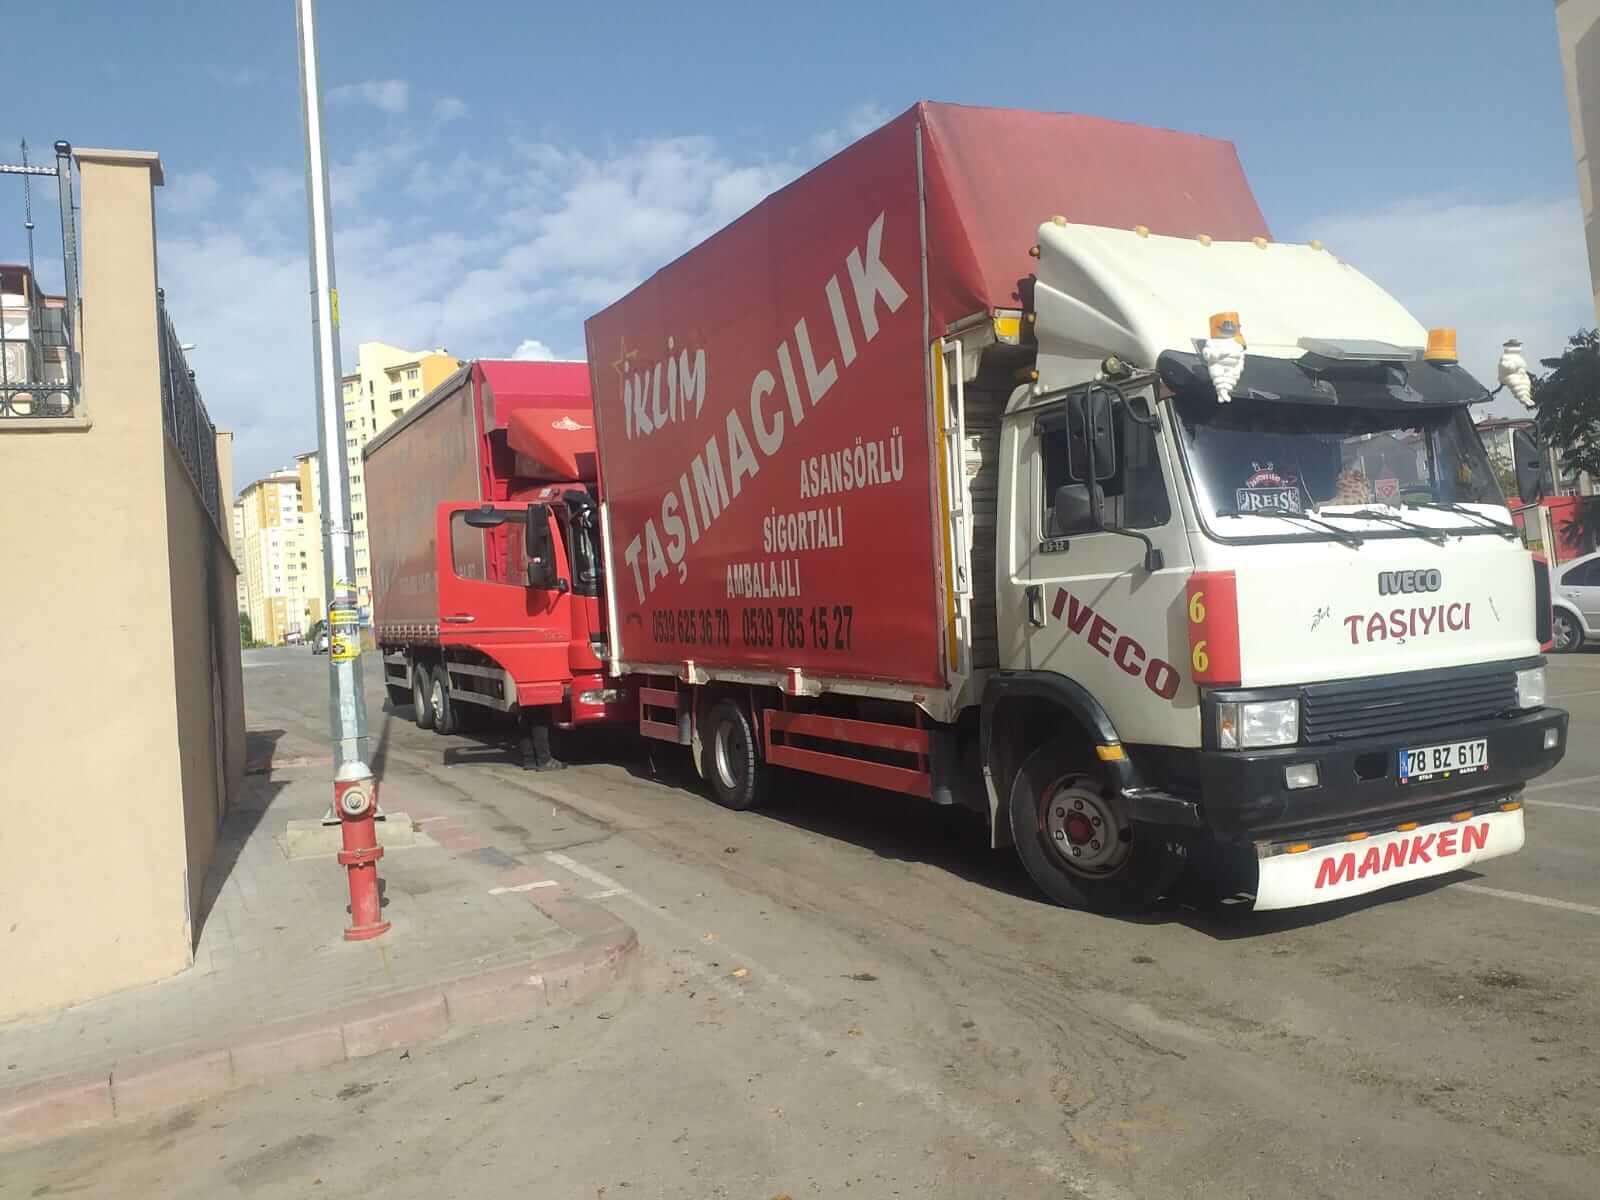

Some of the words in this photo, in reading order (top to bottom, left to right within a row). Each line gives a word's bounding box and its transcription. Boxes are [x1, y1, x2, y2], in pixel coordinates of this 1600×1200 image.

[624, 337, 707, 440] İKLİM
[625, 209, 909, 605] TAŞIMACILIK
[800, 427, 904, 499] ASANSÖRLÜ
[764, 506, 844, 553] SİGORTALI
[727, 558, 801, 599] AMBALAJLI
[1378, 569, 1442, 596] IVECO
[652, 609, 675, 644] 0539
[715, 608, 730, 648] 70
[742, 607, 774, 647] 0539
[777, 607, 805, 649] 785
[809, 607, 829, 650] 15
[833, 606, 853, 650] 27
[1189, 591, 1206, 624] 6
[1344, 602, 1471, 645] TAŞIYICI
[1051, 587, 1181, 700] IVECO
[1192, 640, 1209, 673] 6
[1408, 751, 1426, 774] 78
[1433, 747, 1452, 769] BZ
[1458, 743, 1485, 765] 617
[1314, 822, 1490, 889] MANKEN
